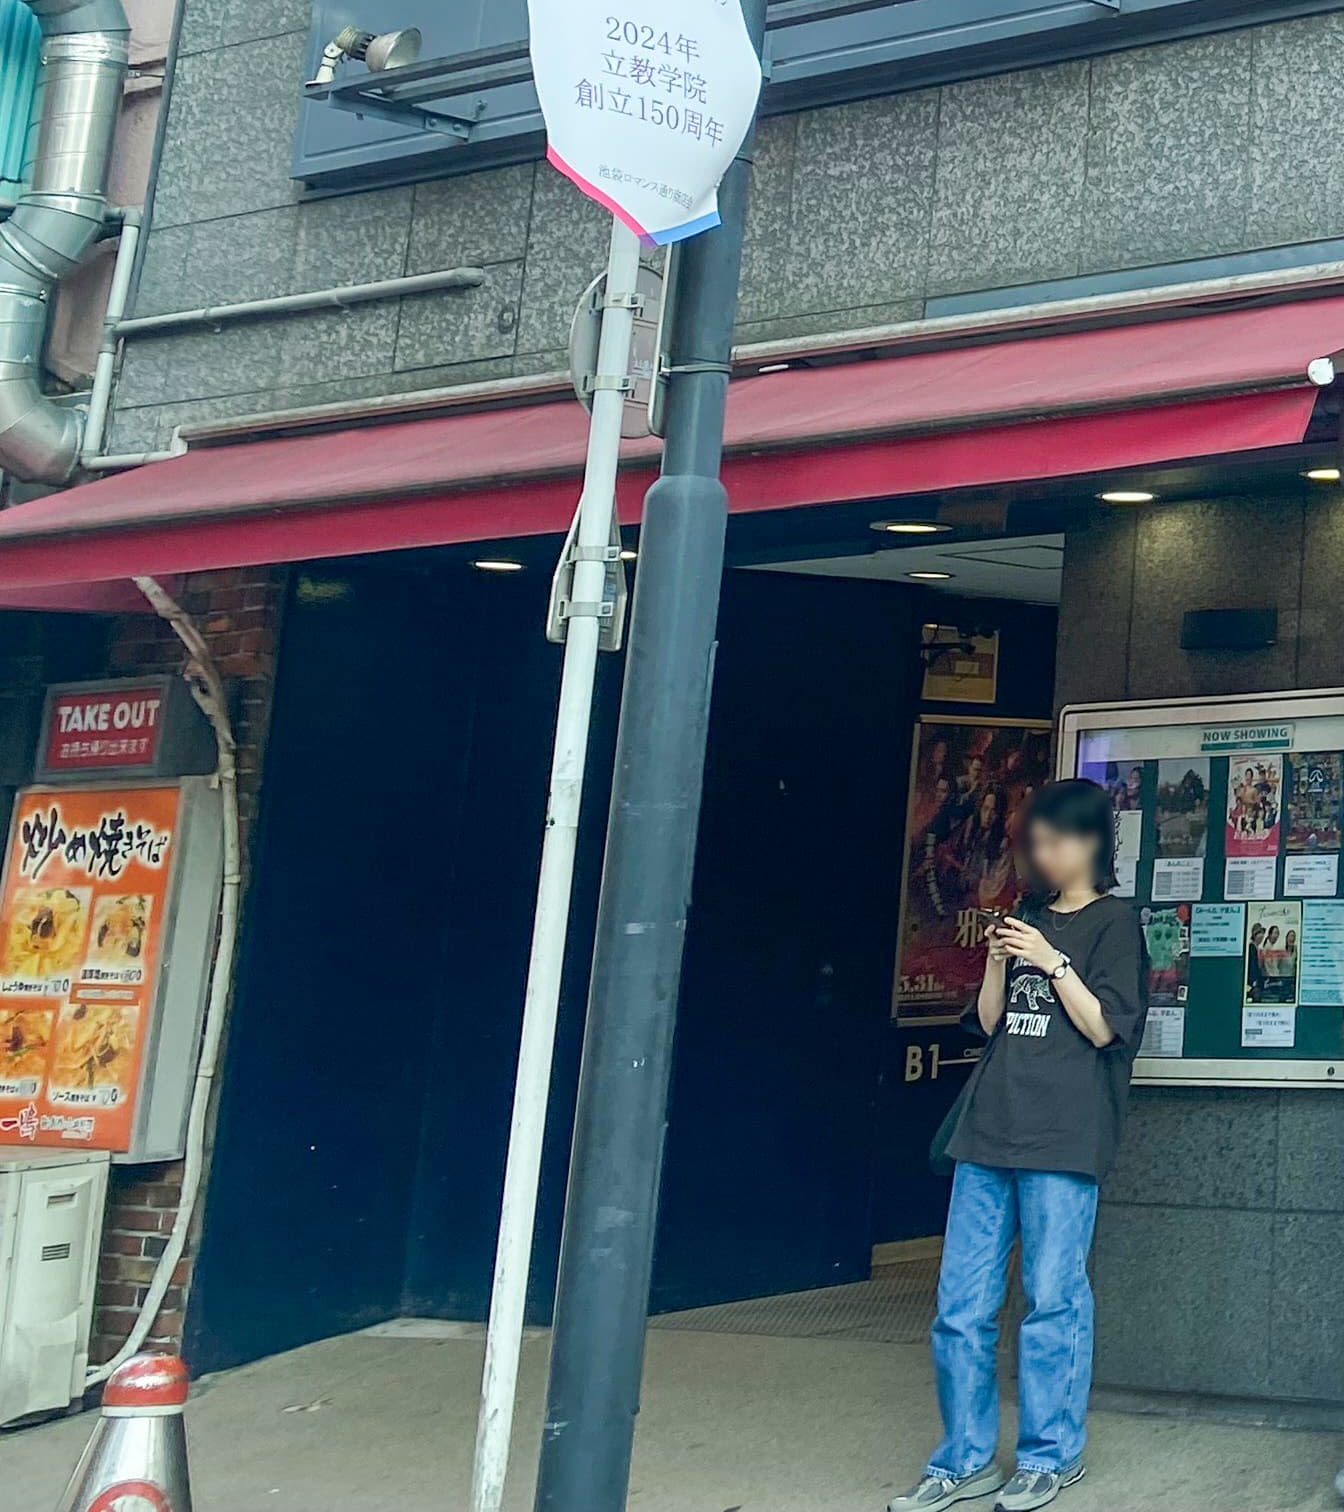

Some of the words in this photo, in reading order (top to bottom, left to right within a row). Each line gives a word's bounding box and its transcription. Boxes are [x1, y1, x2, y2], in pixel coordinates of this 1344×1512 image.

[605, 16, 701, 65] 2024年
[600, 48, 708, 106] 立教学院
[573, 77, 725, 149] 創立150周年
[58, 703, 111, 733] TAKE
[113, 699, 161, 729] OUT
[1203, 730, 1232, 742] NOW
[1233, 726, 1289, 740] SHOWING
[905, 1043, 941, 1082] B1
